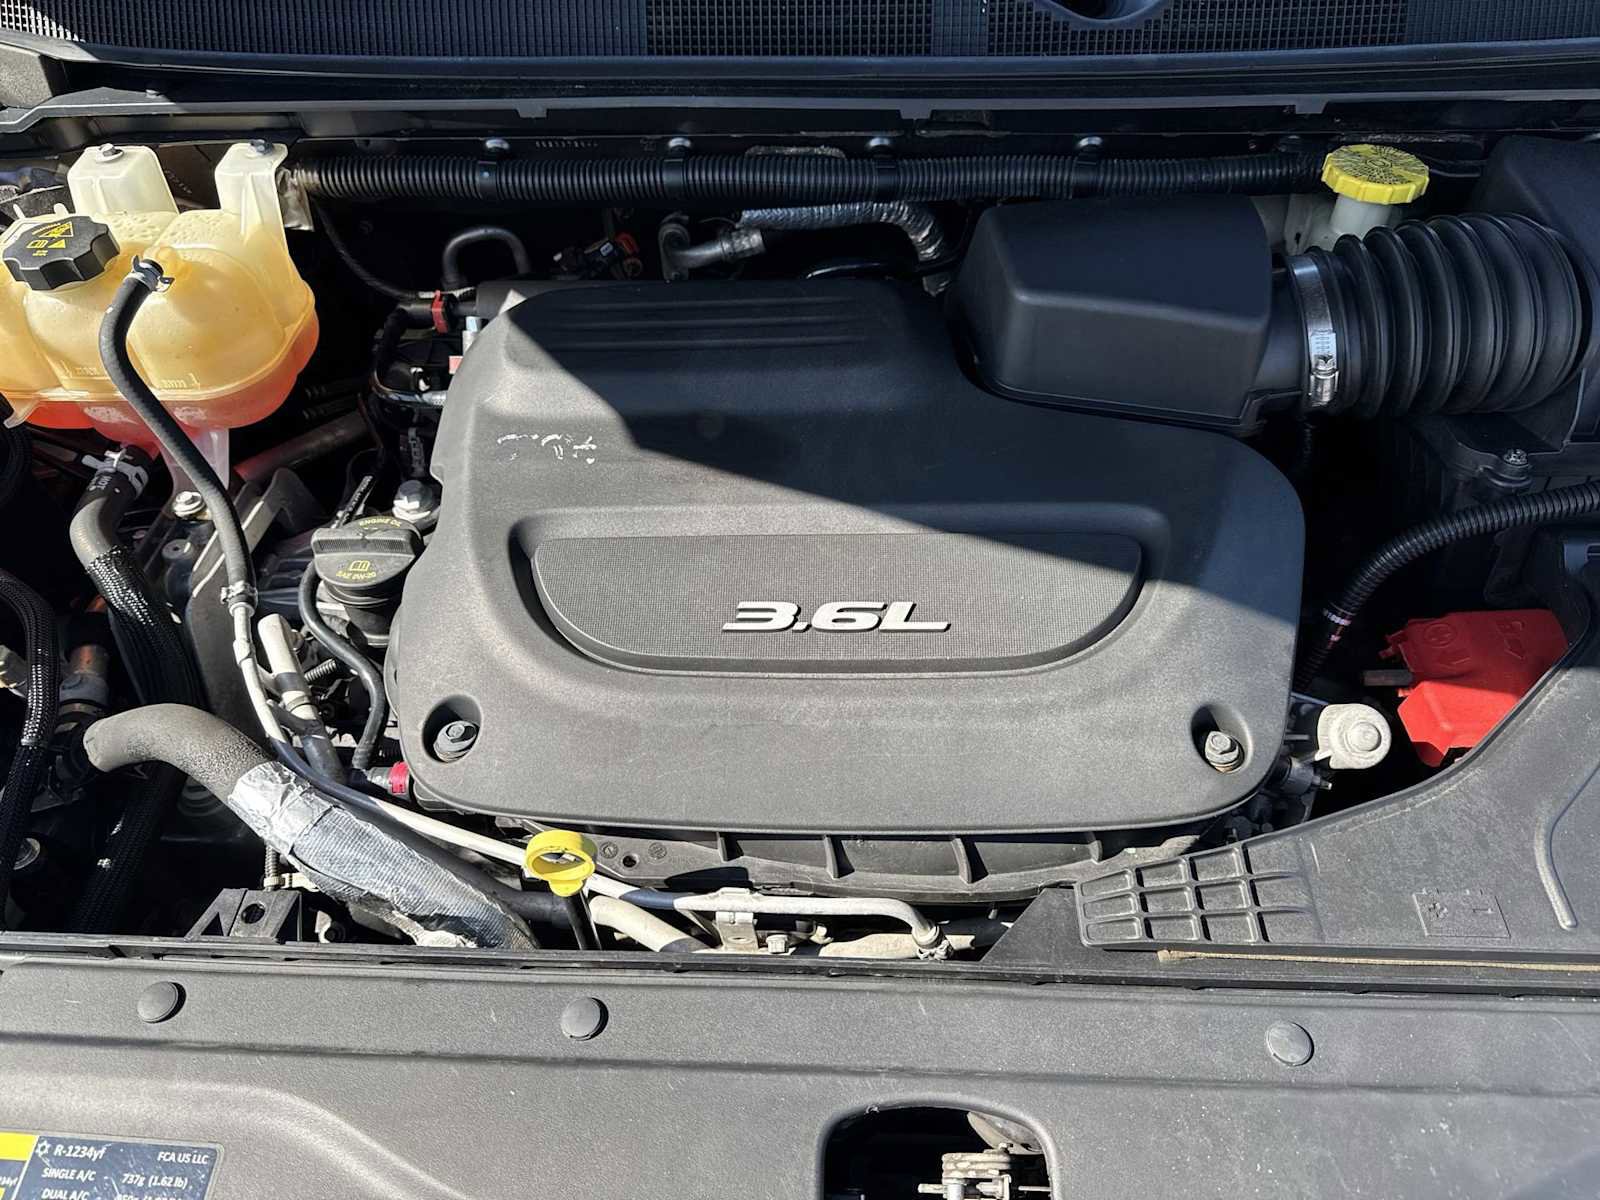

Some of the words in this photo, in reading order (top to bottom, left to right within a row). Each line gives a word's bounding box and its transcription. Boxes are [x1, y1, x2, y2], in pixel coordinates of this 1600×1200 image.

[722, 600, 951, 633] 3.6L
[54, 1145, 106, 1161] R-1234yf
[157, 1151, 176, 1162] FCA
[177, 1153, 192, 1163] US
[192, 1155, 210, 1165] LLC
[42, 1168, 76, 1180] SINGLE
[76, 1169, 97, 1182] A/C
[122, 1174, 145, 1187] 737g
[41, 1187, 68, 1200] DUAL
[68, 1189, 90, 1200] A/C
